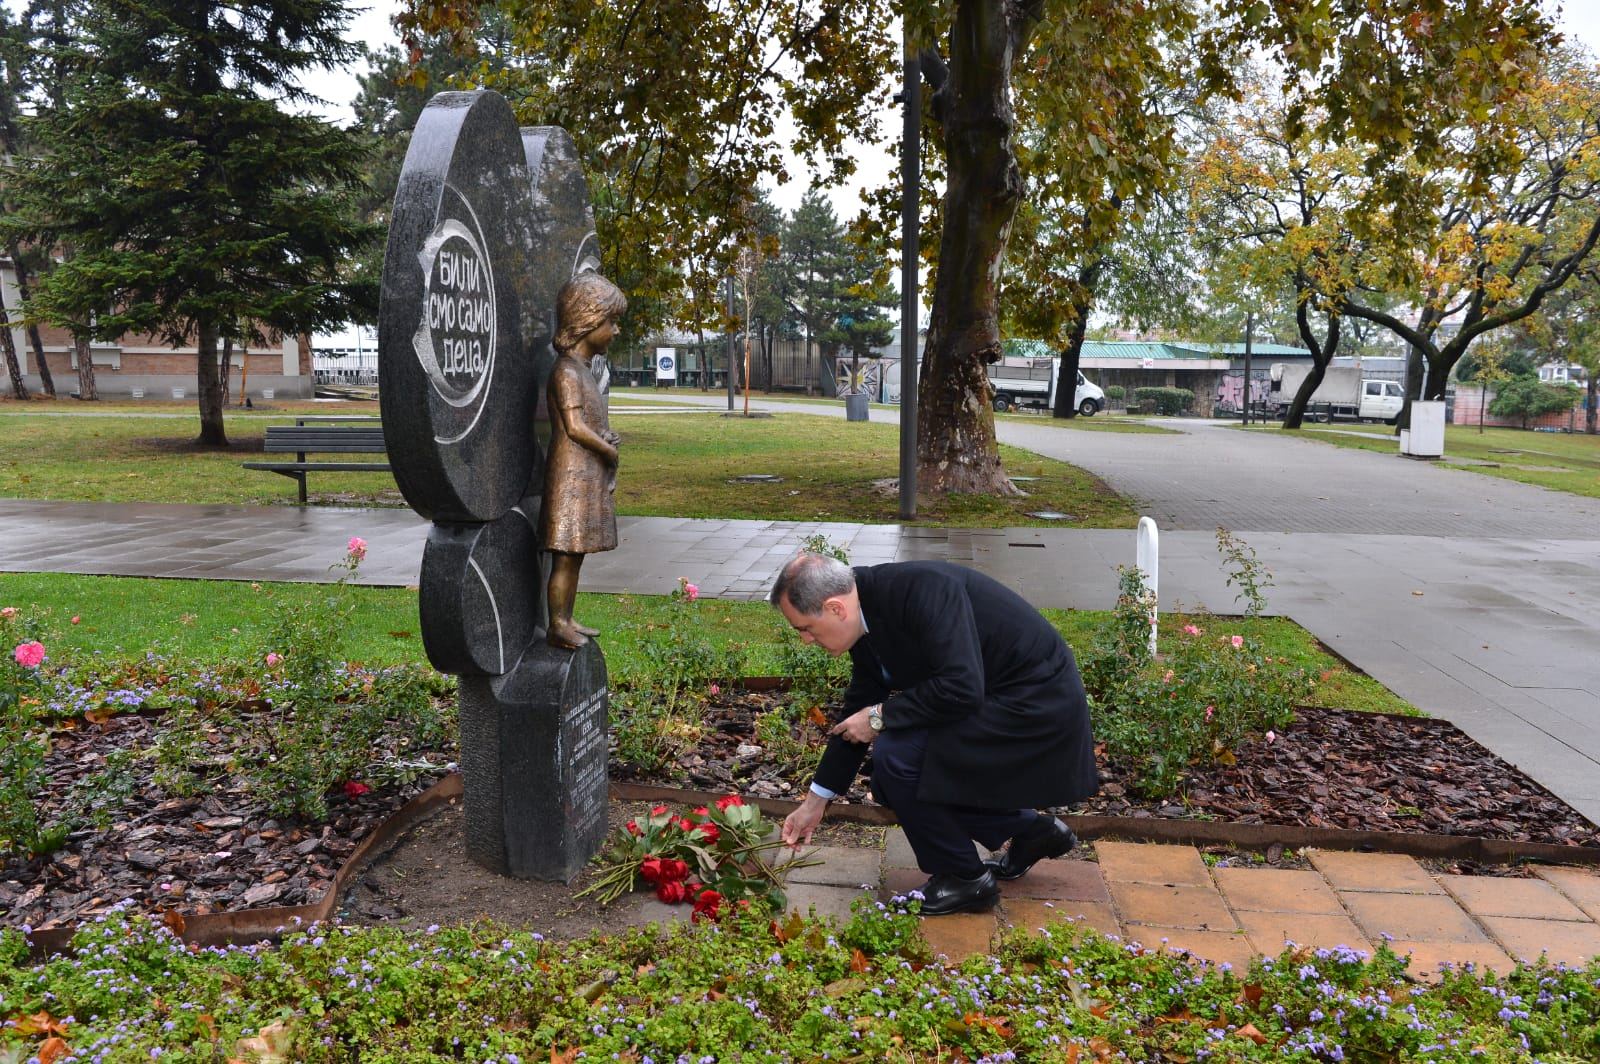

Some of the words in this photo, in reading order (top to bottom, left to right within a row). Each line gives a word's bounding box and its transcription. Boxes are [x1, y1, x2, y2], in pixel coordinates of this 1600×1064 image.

[429, 292, 456, 333] смо
[457, 297, 491, 334] само
[442, 338, 484, 377] деца
